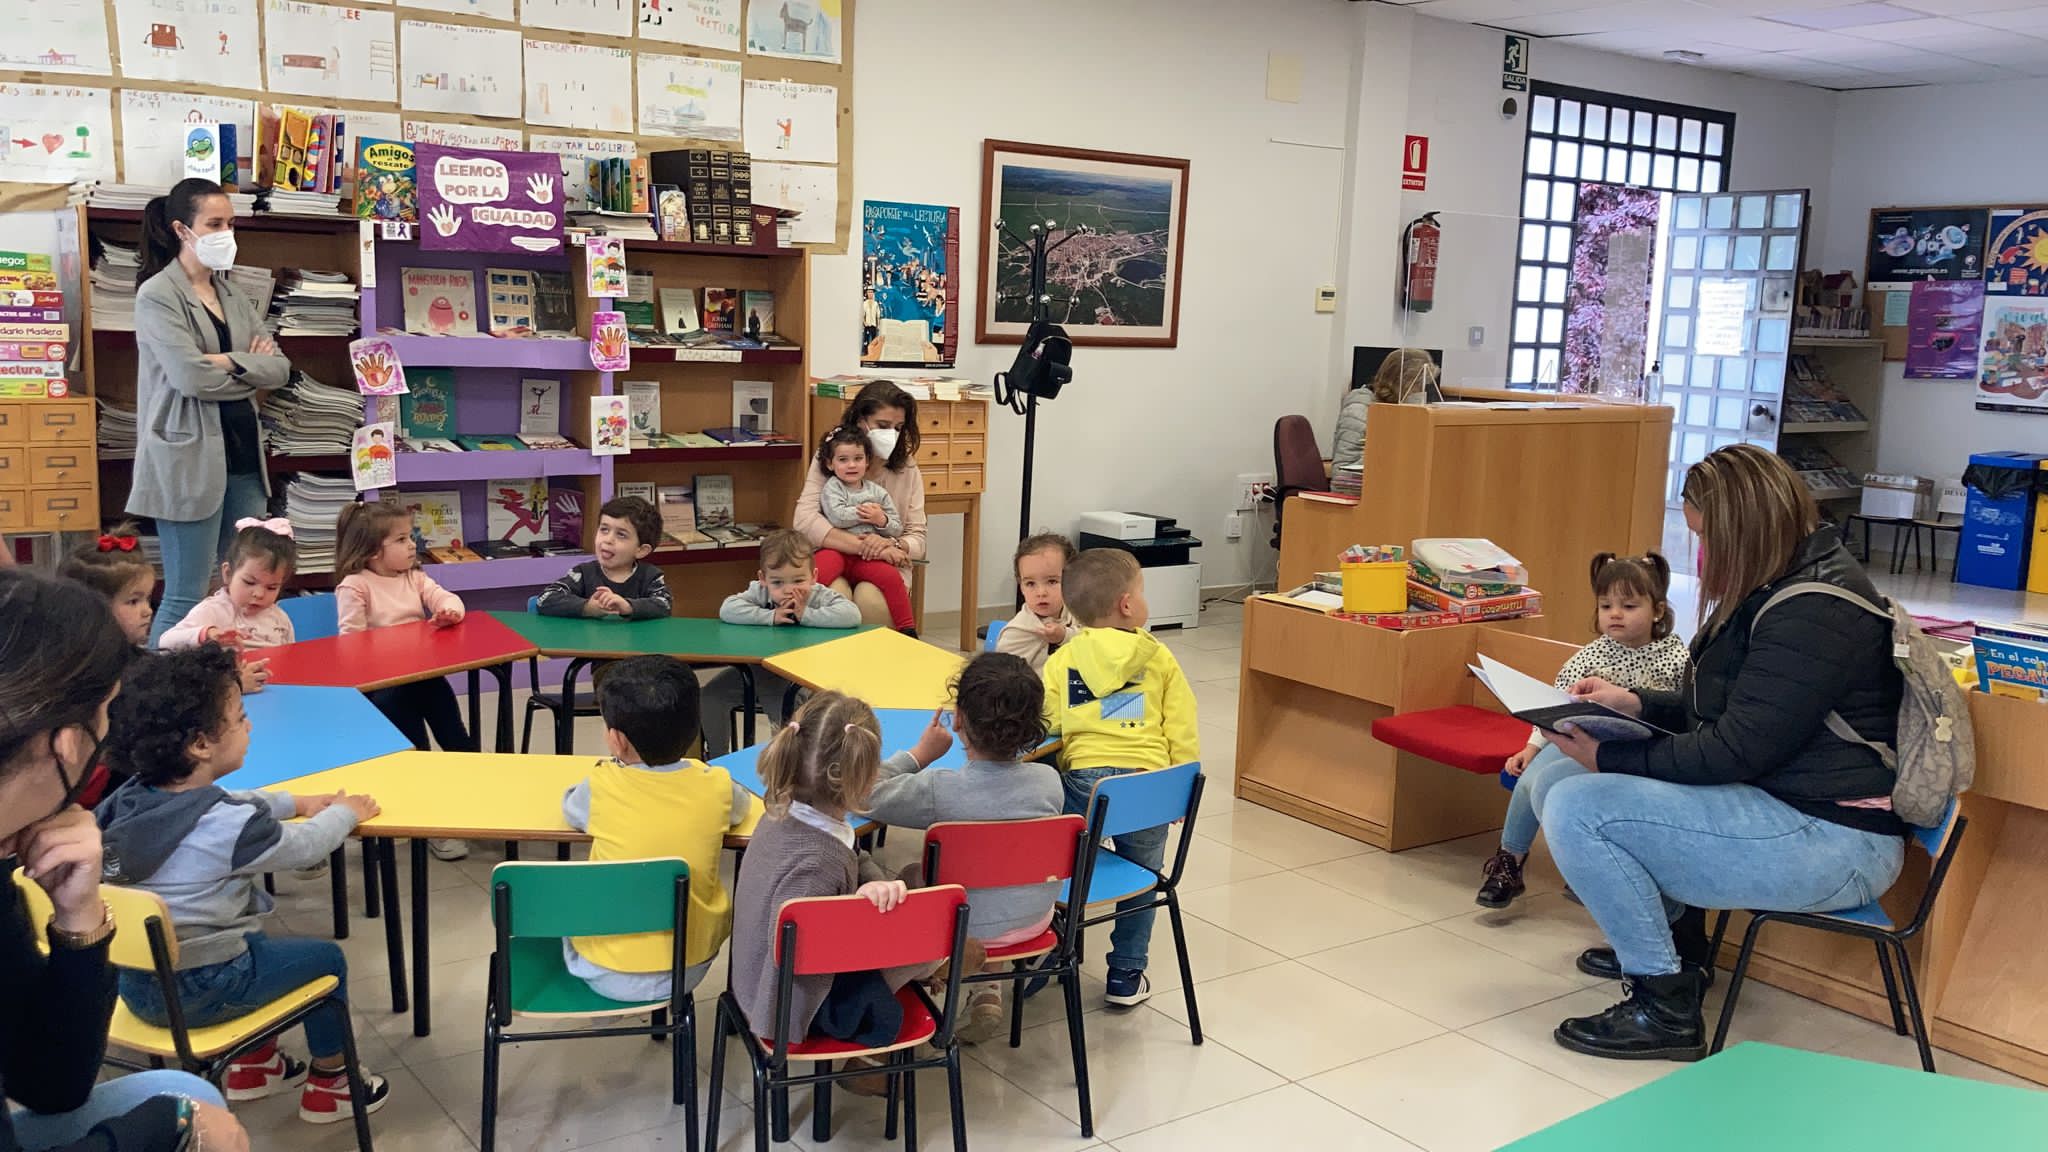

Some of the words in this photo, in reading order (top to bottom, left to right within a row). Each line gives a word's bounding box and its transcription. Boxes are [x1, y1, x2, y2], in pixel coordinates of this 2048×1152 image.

[1503, 74, 1526, 84] SALIDA
[370, 145, 415, 162] Amigos
[372, 160, 409, 169] rescate
[439, 163, 503, 178] LEEMOS
[444, 184, 478, 197] POR
[482, 185, 503, 198] LA
[473, 208, 556, 227] IGUALDAD
[26, 327, 63, 336] Madera
[1990, 648, 2005, 660] En
[2008, 651, 2019, 662] el
